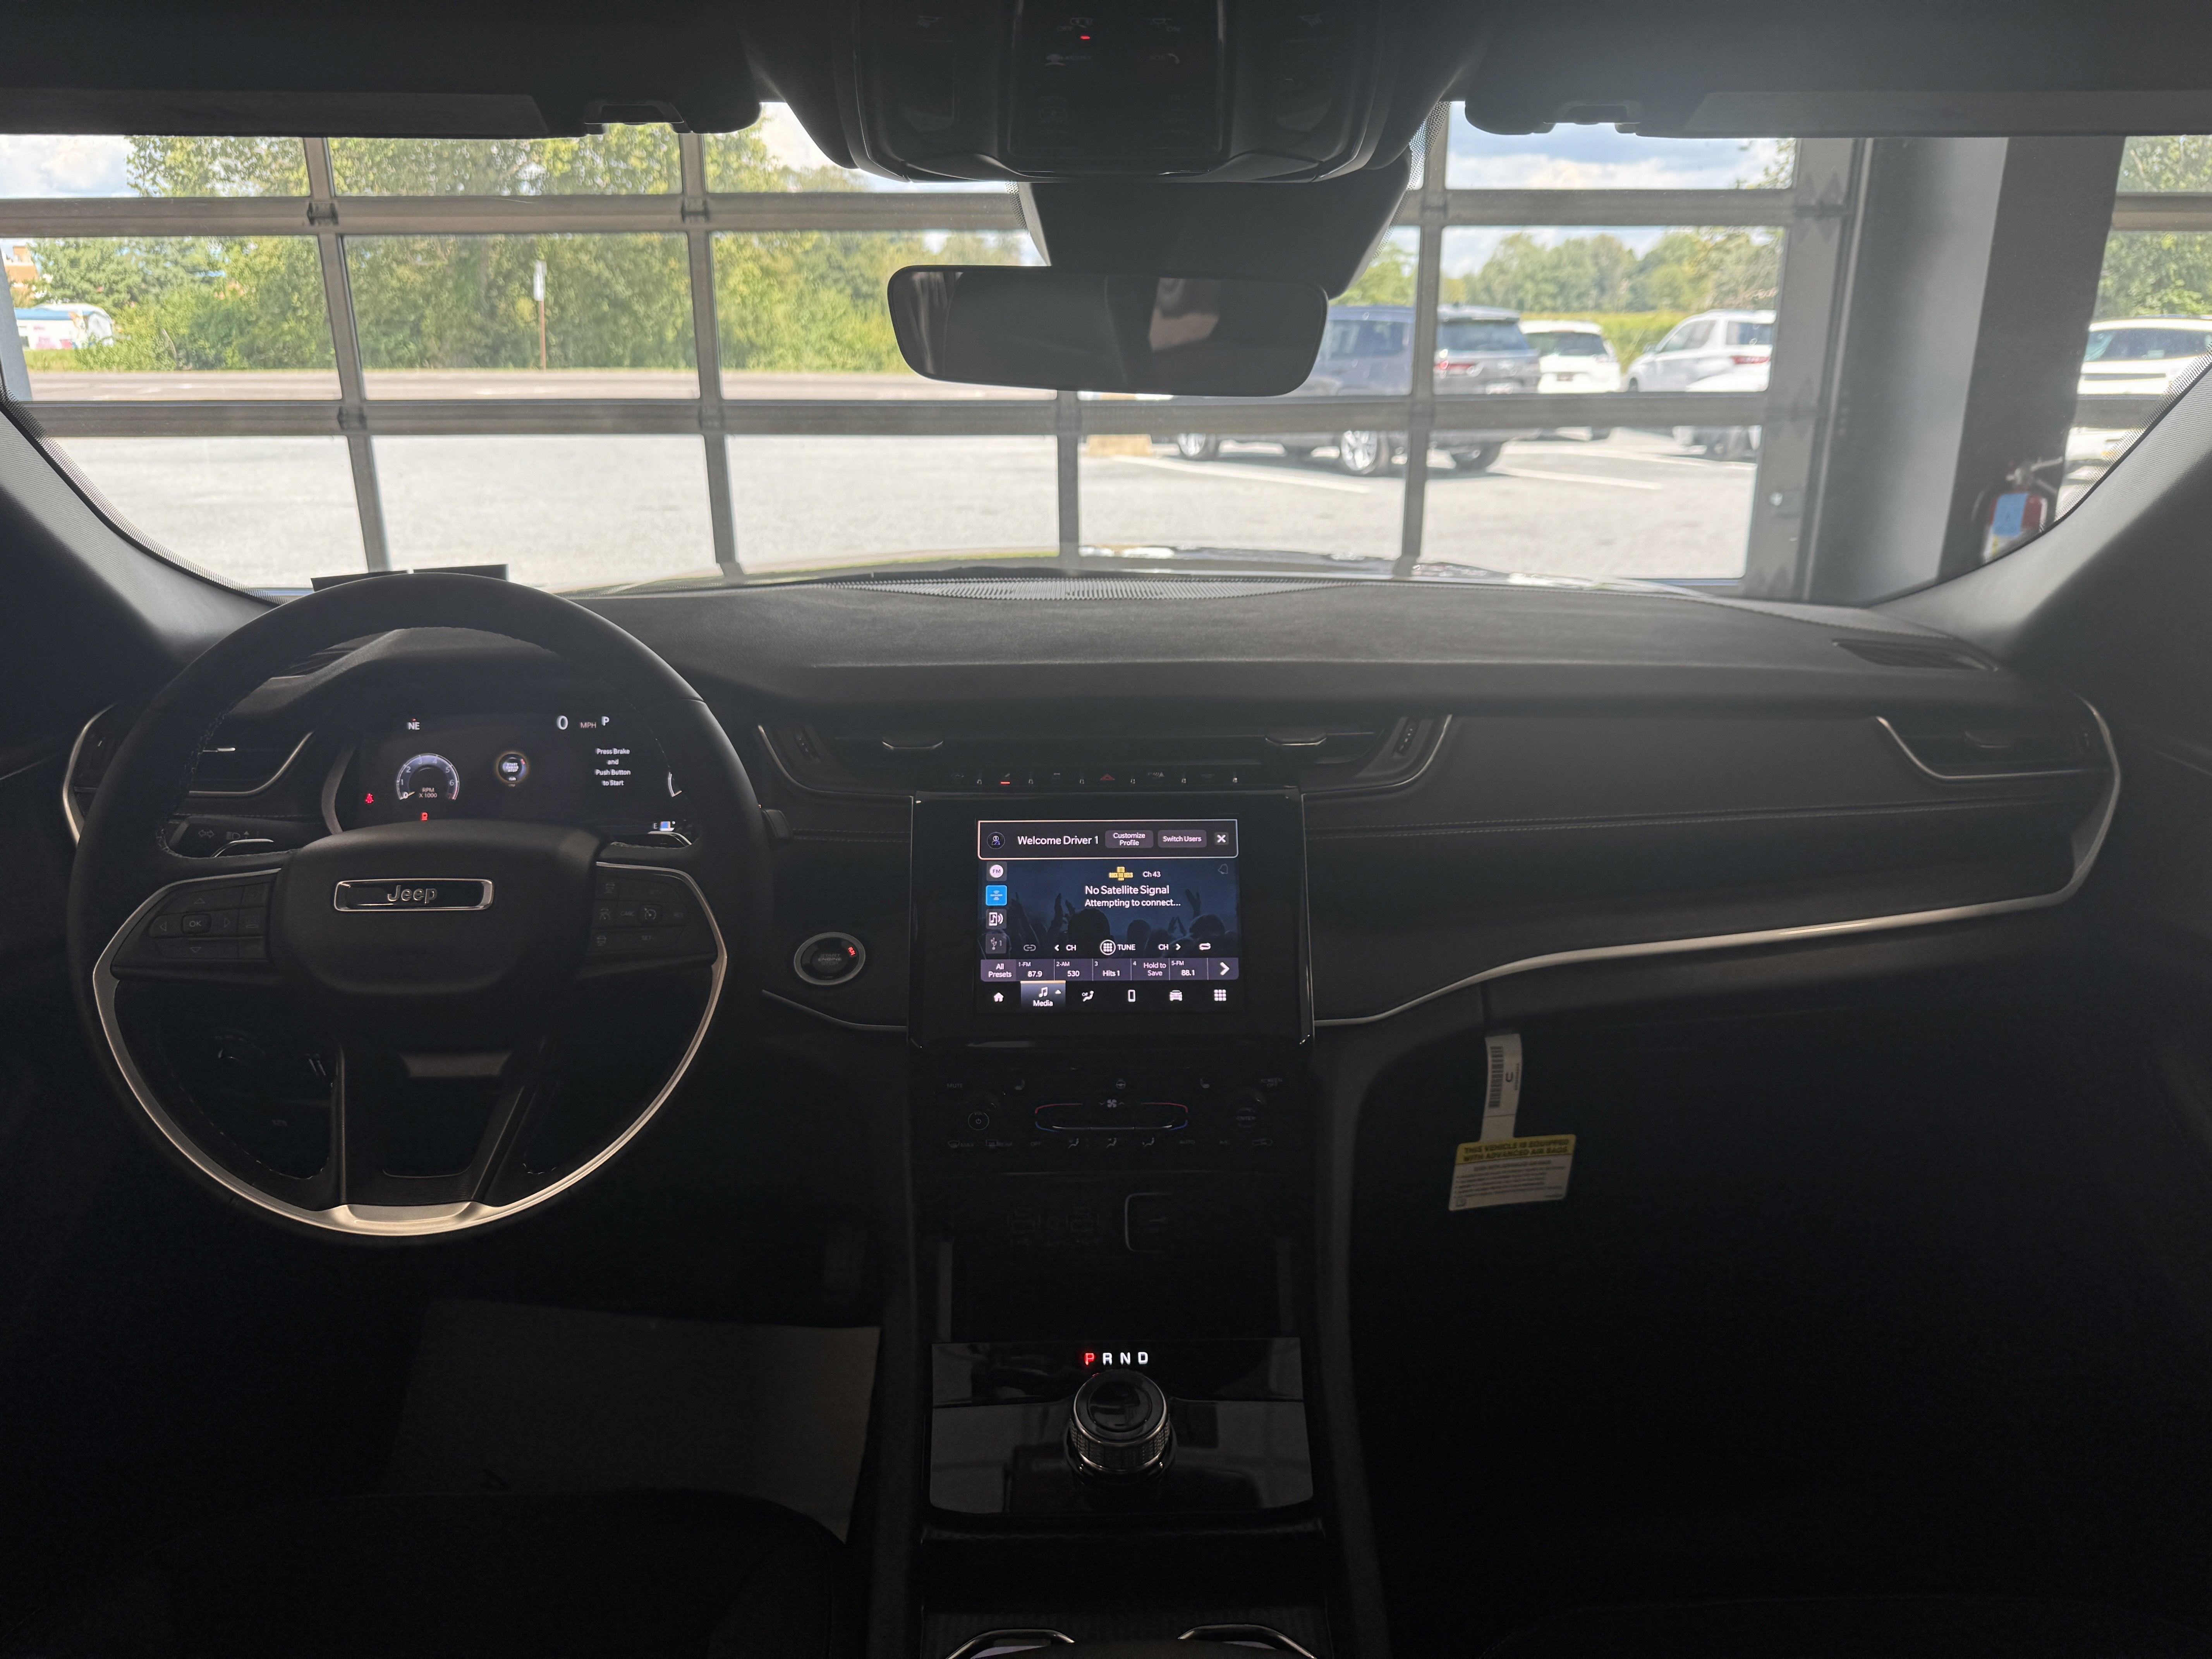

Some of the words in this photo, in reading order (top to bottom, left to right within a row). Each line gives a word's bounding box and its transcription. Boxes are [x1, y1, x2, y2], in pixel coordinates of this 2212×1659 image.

[408, 722, 420, 730] NE
[601, 716, 610, 726] P
[1018, 836, 1061, 845] Welcome
[1063, 836, 1092, 845] Driver
[1094, 836, 1099, 844] 1
[387, 885, 437, 904] Jeep
[1085, 886, 1099, 895] No
[1101, 885, 1139, 895] Satellite
[1140, 885, 1169, 896] Signal
[1085, 898, 1130, 908] Attempting
[1085, 1353, 1094, 1365] P
[1103, 1352, 1112, 1365] R
[1120, 1352, 1131, 1365] N
[1138, 1352, 1148, 1364] D
